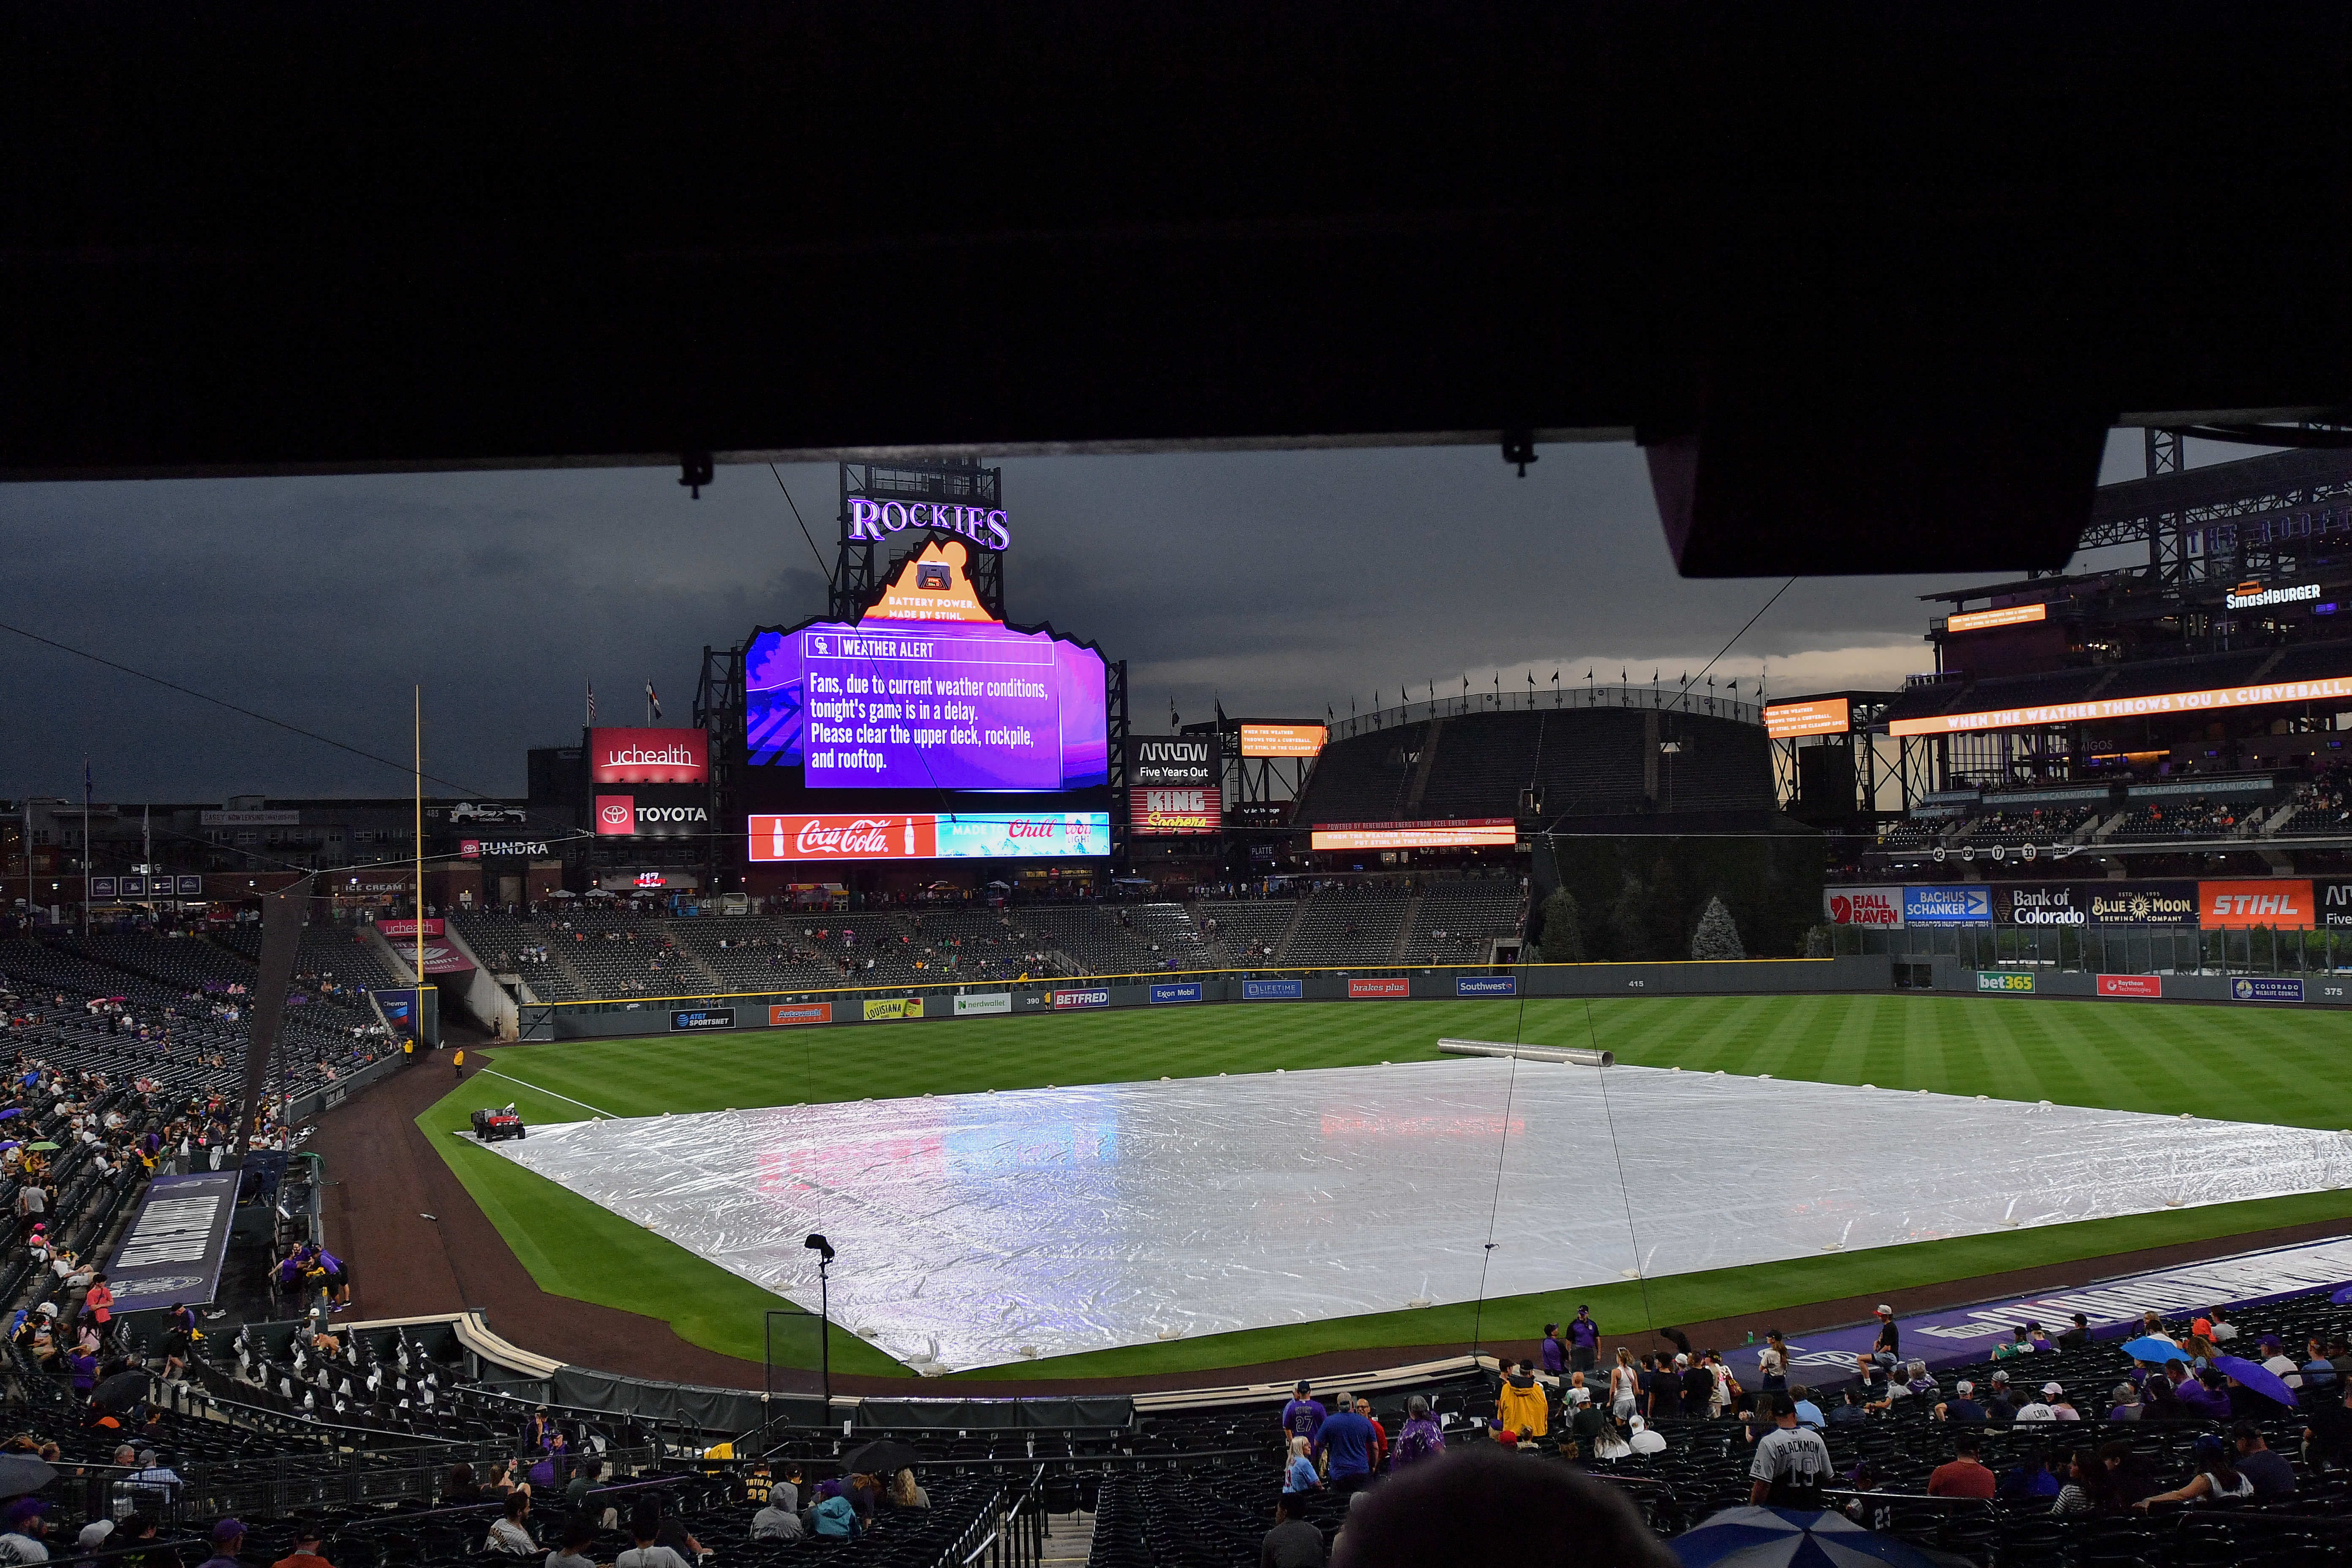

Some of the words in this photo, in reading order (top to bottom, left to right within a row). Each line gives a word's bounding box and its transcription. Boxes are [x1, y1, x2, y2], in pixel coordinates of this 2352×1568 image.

[848, 499, 1010, 550] ROCKIES
[889, 596, 934, 607] BATTERY
[937, 598, 976, 608] POWER.
[889, 610, 916, 618] MADE
[920, 611, 932, 619] BY
[935, 612, 965, 620] STIHL.
[843, 639, 896, 657] WEATHER
[899, 642, 934, 658] ALERT
[810, 672, 843, 696] Fans,
[847, 674, 869, 694] due
[872, 675, 885, 694] to
[888, 676, 933, 696] current
[935, 677, 984, 697] weather
[987, 678, 1048, 701] conditions,
[810, 698, 866, 722] tonight's
[869, 704, 902, 723] game
[906, 700, 916, 719] is
[919, 700, 930, 719] in
[934, 706, 941, 720] a
[944, 701, 978, 724] delay.
[1947, 715, 1988, 728] WHEN
[1993, 711, 2021, 725] THE
[2026, 705, 2097, 721] WEATHER
[2102, 698, 2170, 715] THROWS
[2177, 693, 2212, 708] YOU
[2219, 692, 2230, 705] A
[2236, 681, 2351, 702] CURVEBALL,
[811, 723, 853, 743] Please
[856, 724, 887, 743] clear
[890, 725, 911, 744] the
[914, 728, 947, 748] upper
[950, 726, 982, 748] deck,
[985, 726, 1034, 749] rockpile,
[610, 744, 691, 764] uchealth
[1139, 743, 1208, 761] ARROW
[811, 749, 834, 768] and
[838, 749, 887, 773] rooftop.
[1140, 767, 1160, 777] Five
[1162, 767, 1188, 777] Years
[1190, 767, 1209, 777] Out
[1147, 791, 1205, 811] KING
[635, 808, 708, 822] TOYOTA
[1146, 811, 1206, 834] Soopers
[953, 825, 987, 835] MADE
[1009, 819, 1057, 838] Chill
[479, 842, 549, 855] TUNDRA
[1252, 847, 1272, 855] PLATTE
[1934, 849, 1943, 859] 42
[1994, 849, 2002, 858] 17
[2025, 848, 2034, 858] 33
[1853, 894, 1890, 909] FJÄLL
[1921, 892, 1965, 903] BACHUS
[2014, 889, 2050, 906] Bank
[2054, 888, 2069, 906] of
[1907, 904, 1965, 915] SCHANKER
[2092, 897, 2126, 915] BLUE
[2213, 895, 2298, 915] STIHL
[1853, 909, 1897, 923] RÄVEN
[2014, 906, 2085, 924] Colorado
[2327, 913, 2352, 924] Five
[1353, 983, 1383, 991] brakes
[1460, 982, 1506, 991] Southwest
[1980, 975, 2033, 990] bet365
[1056, 992, 1107, 1004] BETFRED
[1157, 991, 1175, 999] Exxon
[2325, 988, 2343, 996] 375
[778, 1009, 820, 1018] Autowash
[866, 1004, 901, 1019] LOUISIANA
[1948, 1325, 1998, 1336] 1993
[1296, 1416, 1314, 1432] 27
[1777, 1440, 1820, 1456] BLACKMON
[1786, 1457, 1814, 1487] 19
